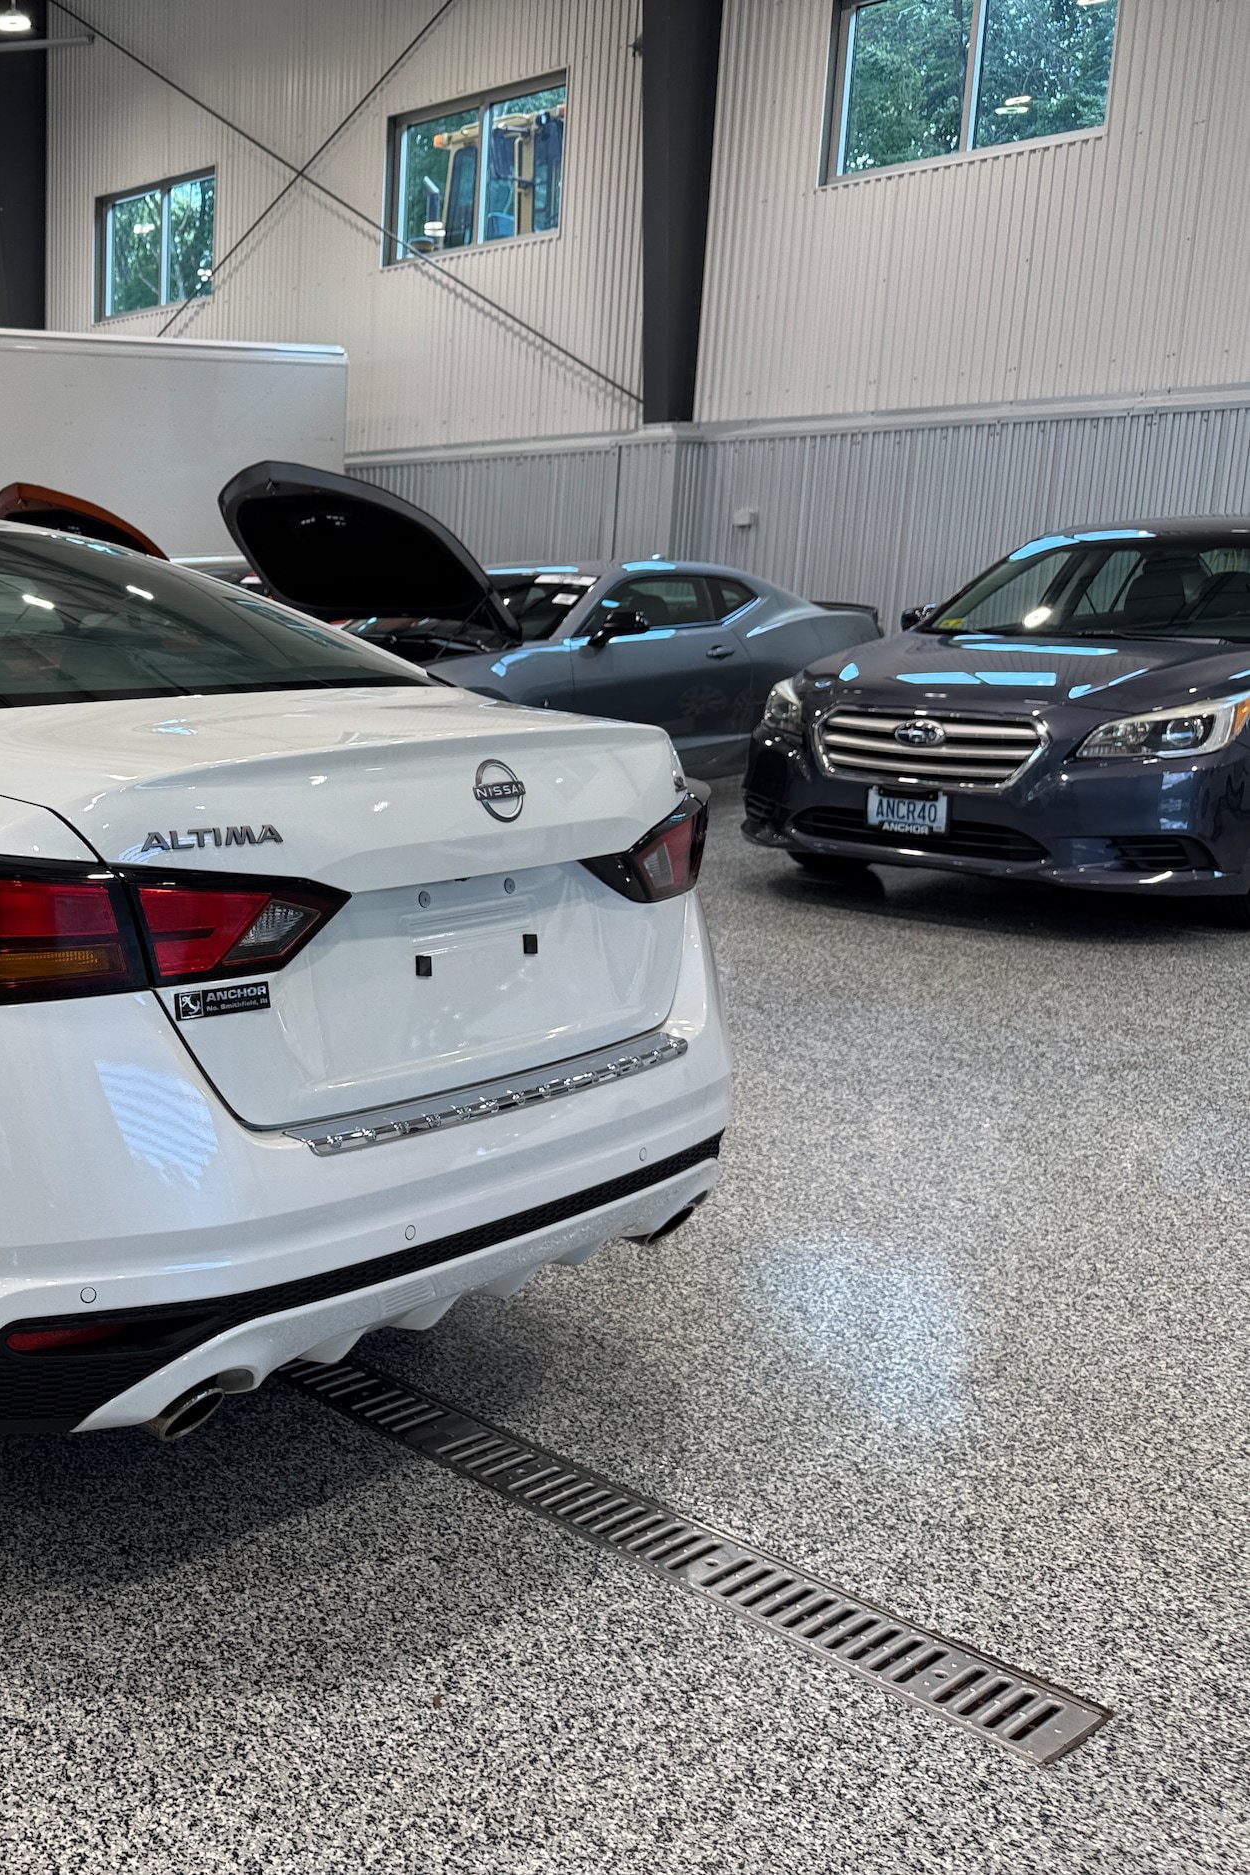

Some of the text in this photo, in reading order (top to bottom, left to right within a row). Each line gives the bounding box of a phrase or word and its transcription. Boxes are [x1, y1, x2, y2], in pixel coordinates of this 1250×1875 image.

[476, 784, 525, 798] NISSAN
[876, 799, 937, 823] ANCR40
[882, 822, 929, 835] ANCHOR
[141, 824, 283, 852] ALTIMA
[206, 985, 267, 1002] ANCHOR
